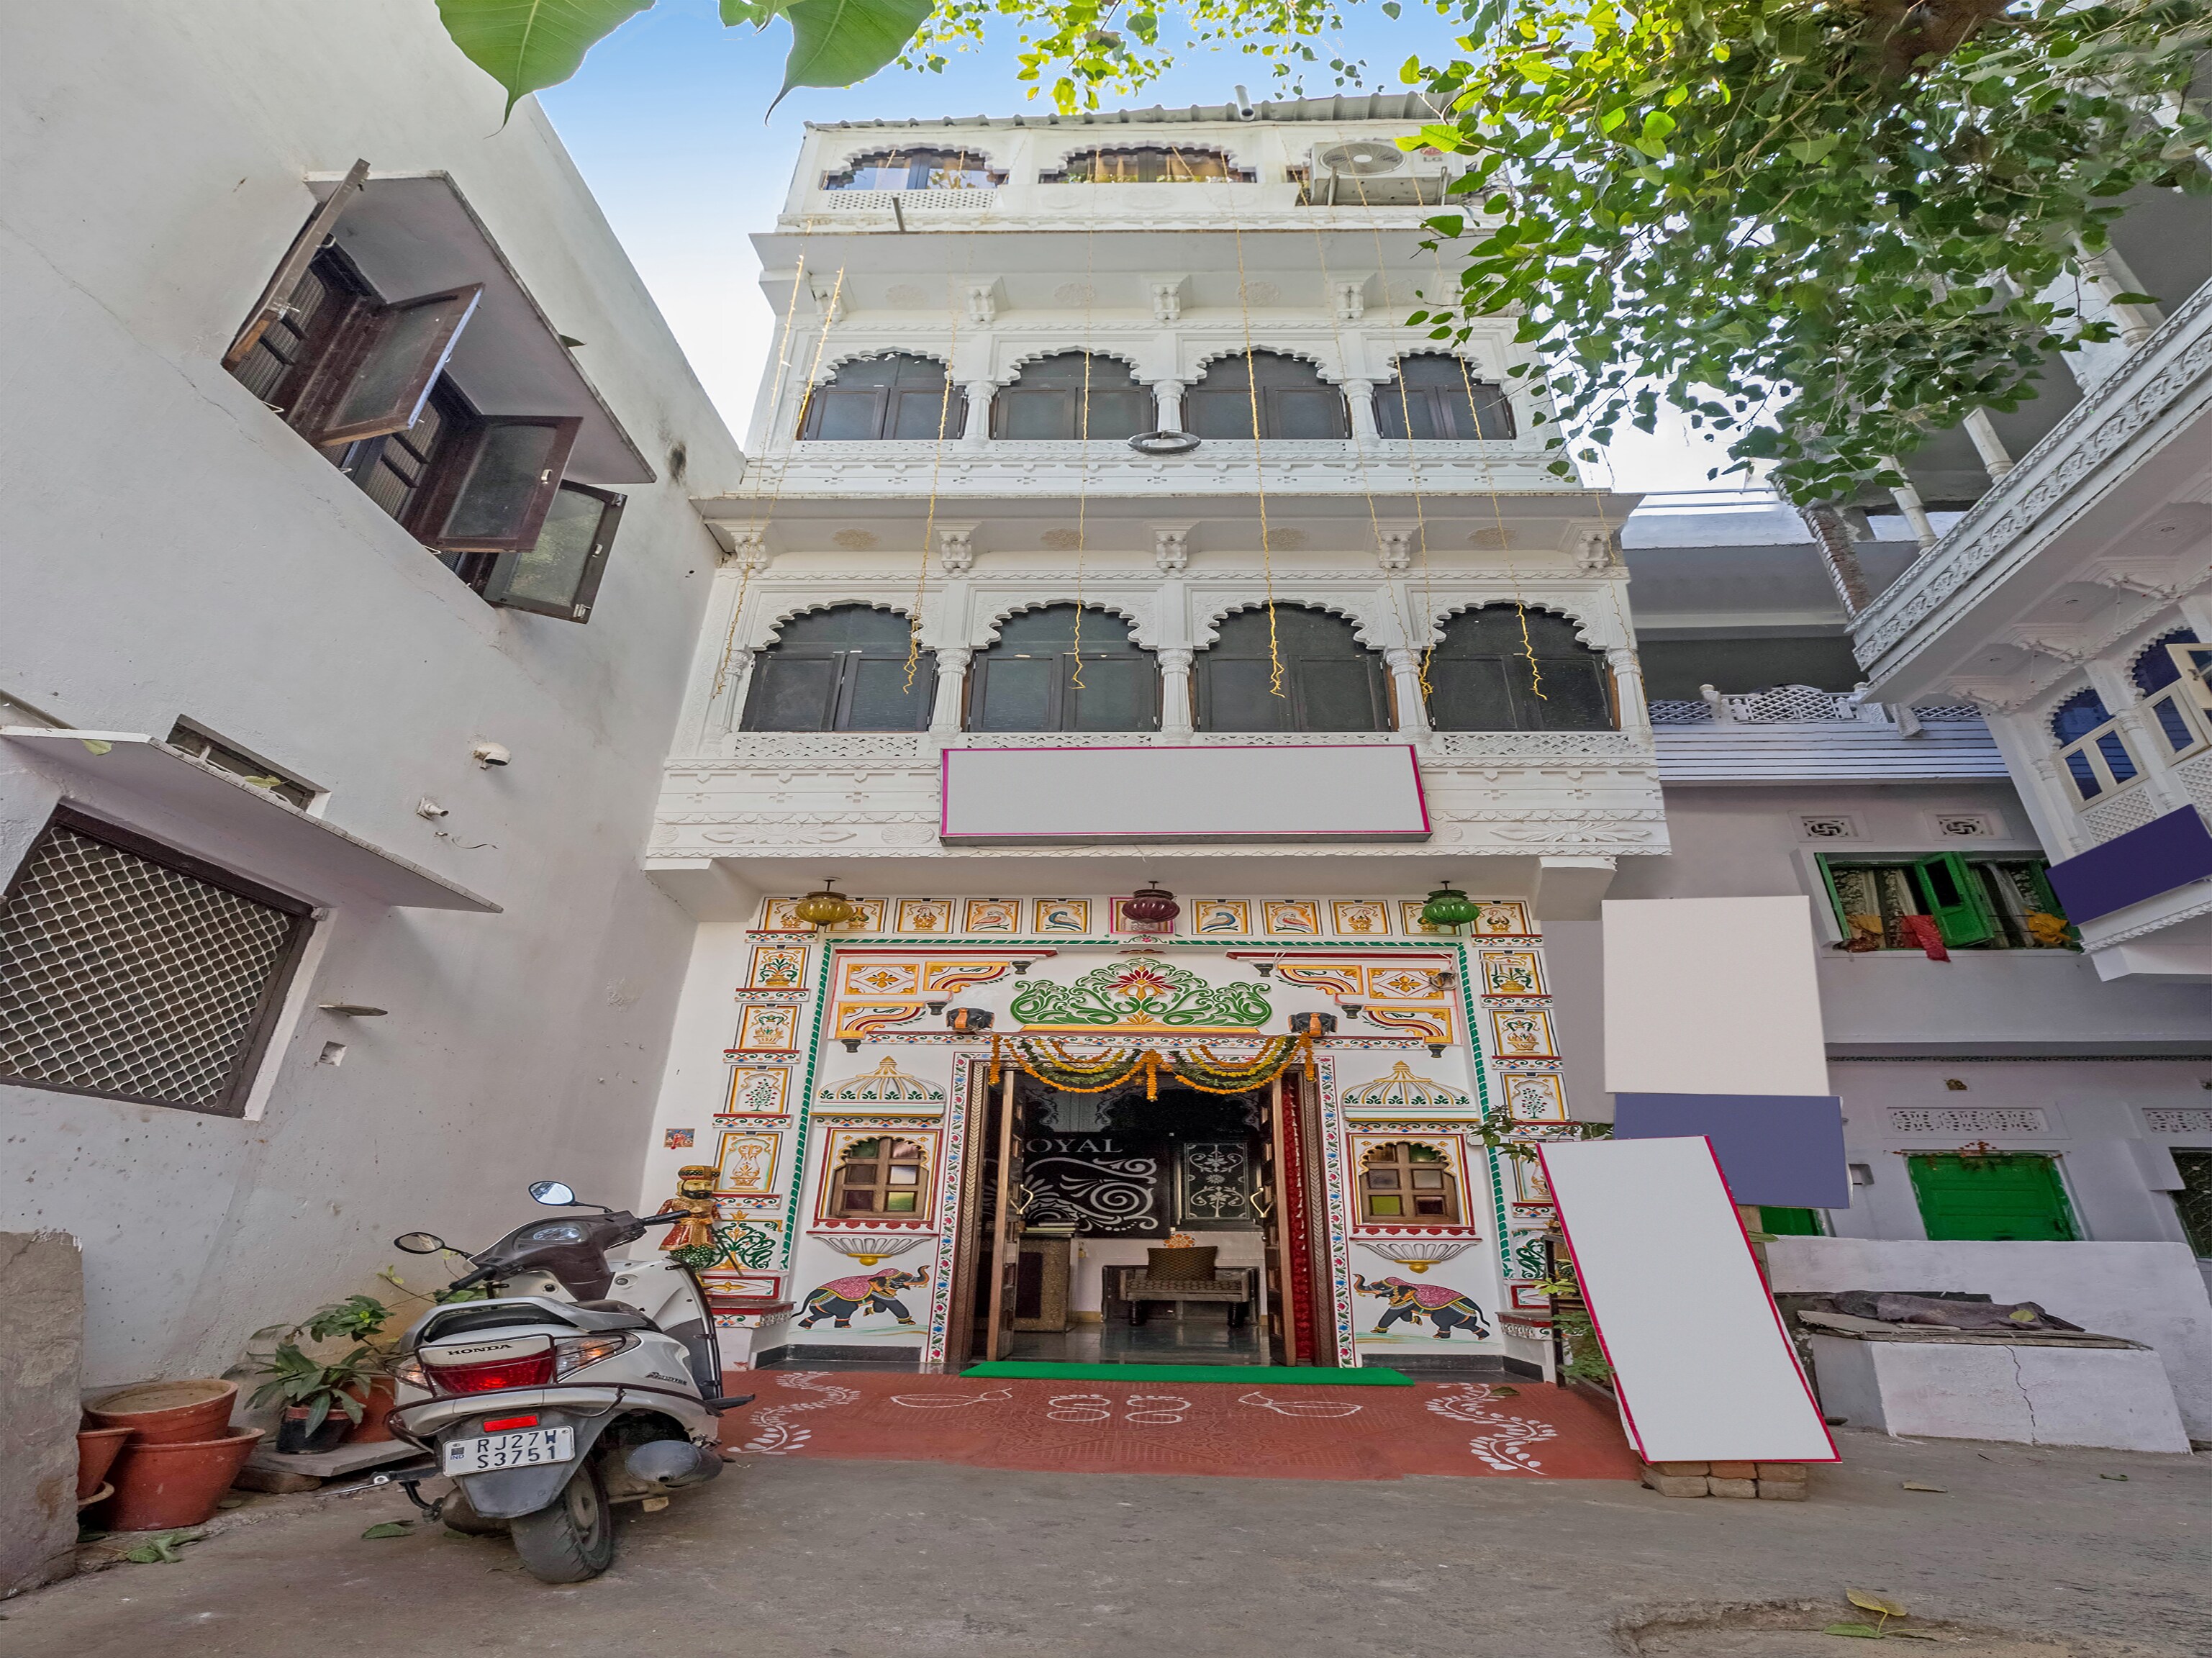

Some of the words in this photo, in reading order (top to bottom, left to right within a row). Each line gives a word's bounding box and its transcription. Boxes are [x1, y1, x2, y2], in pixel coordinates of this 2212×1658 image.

[1025, 1138, 1123, 1153] OYAL
[447, 1344, 512, 1355] HONDA
[477, 1445, 556, 1469] S3751
